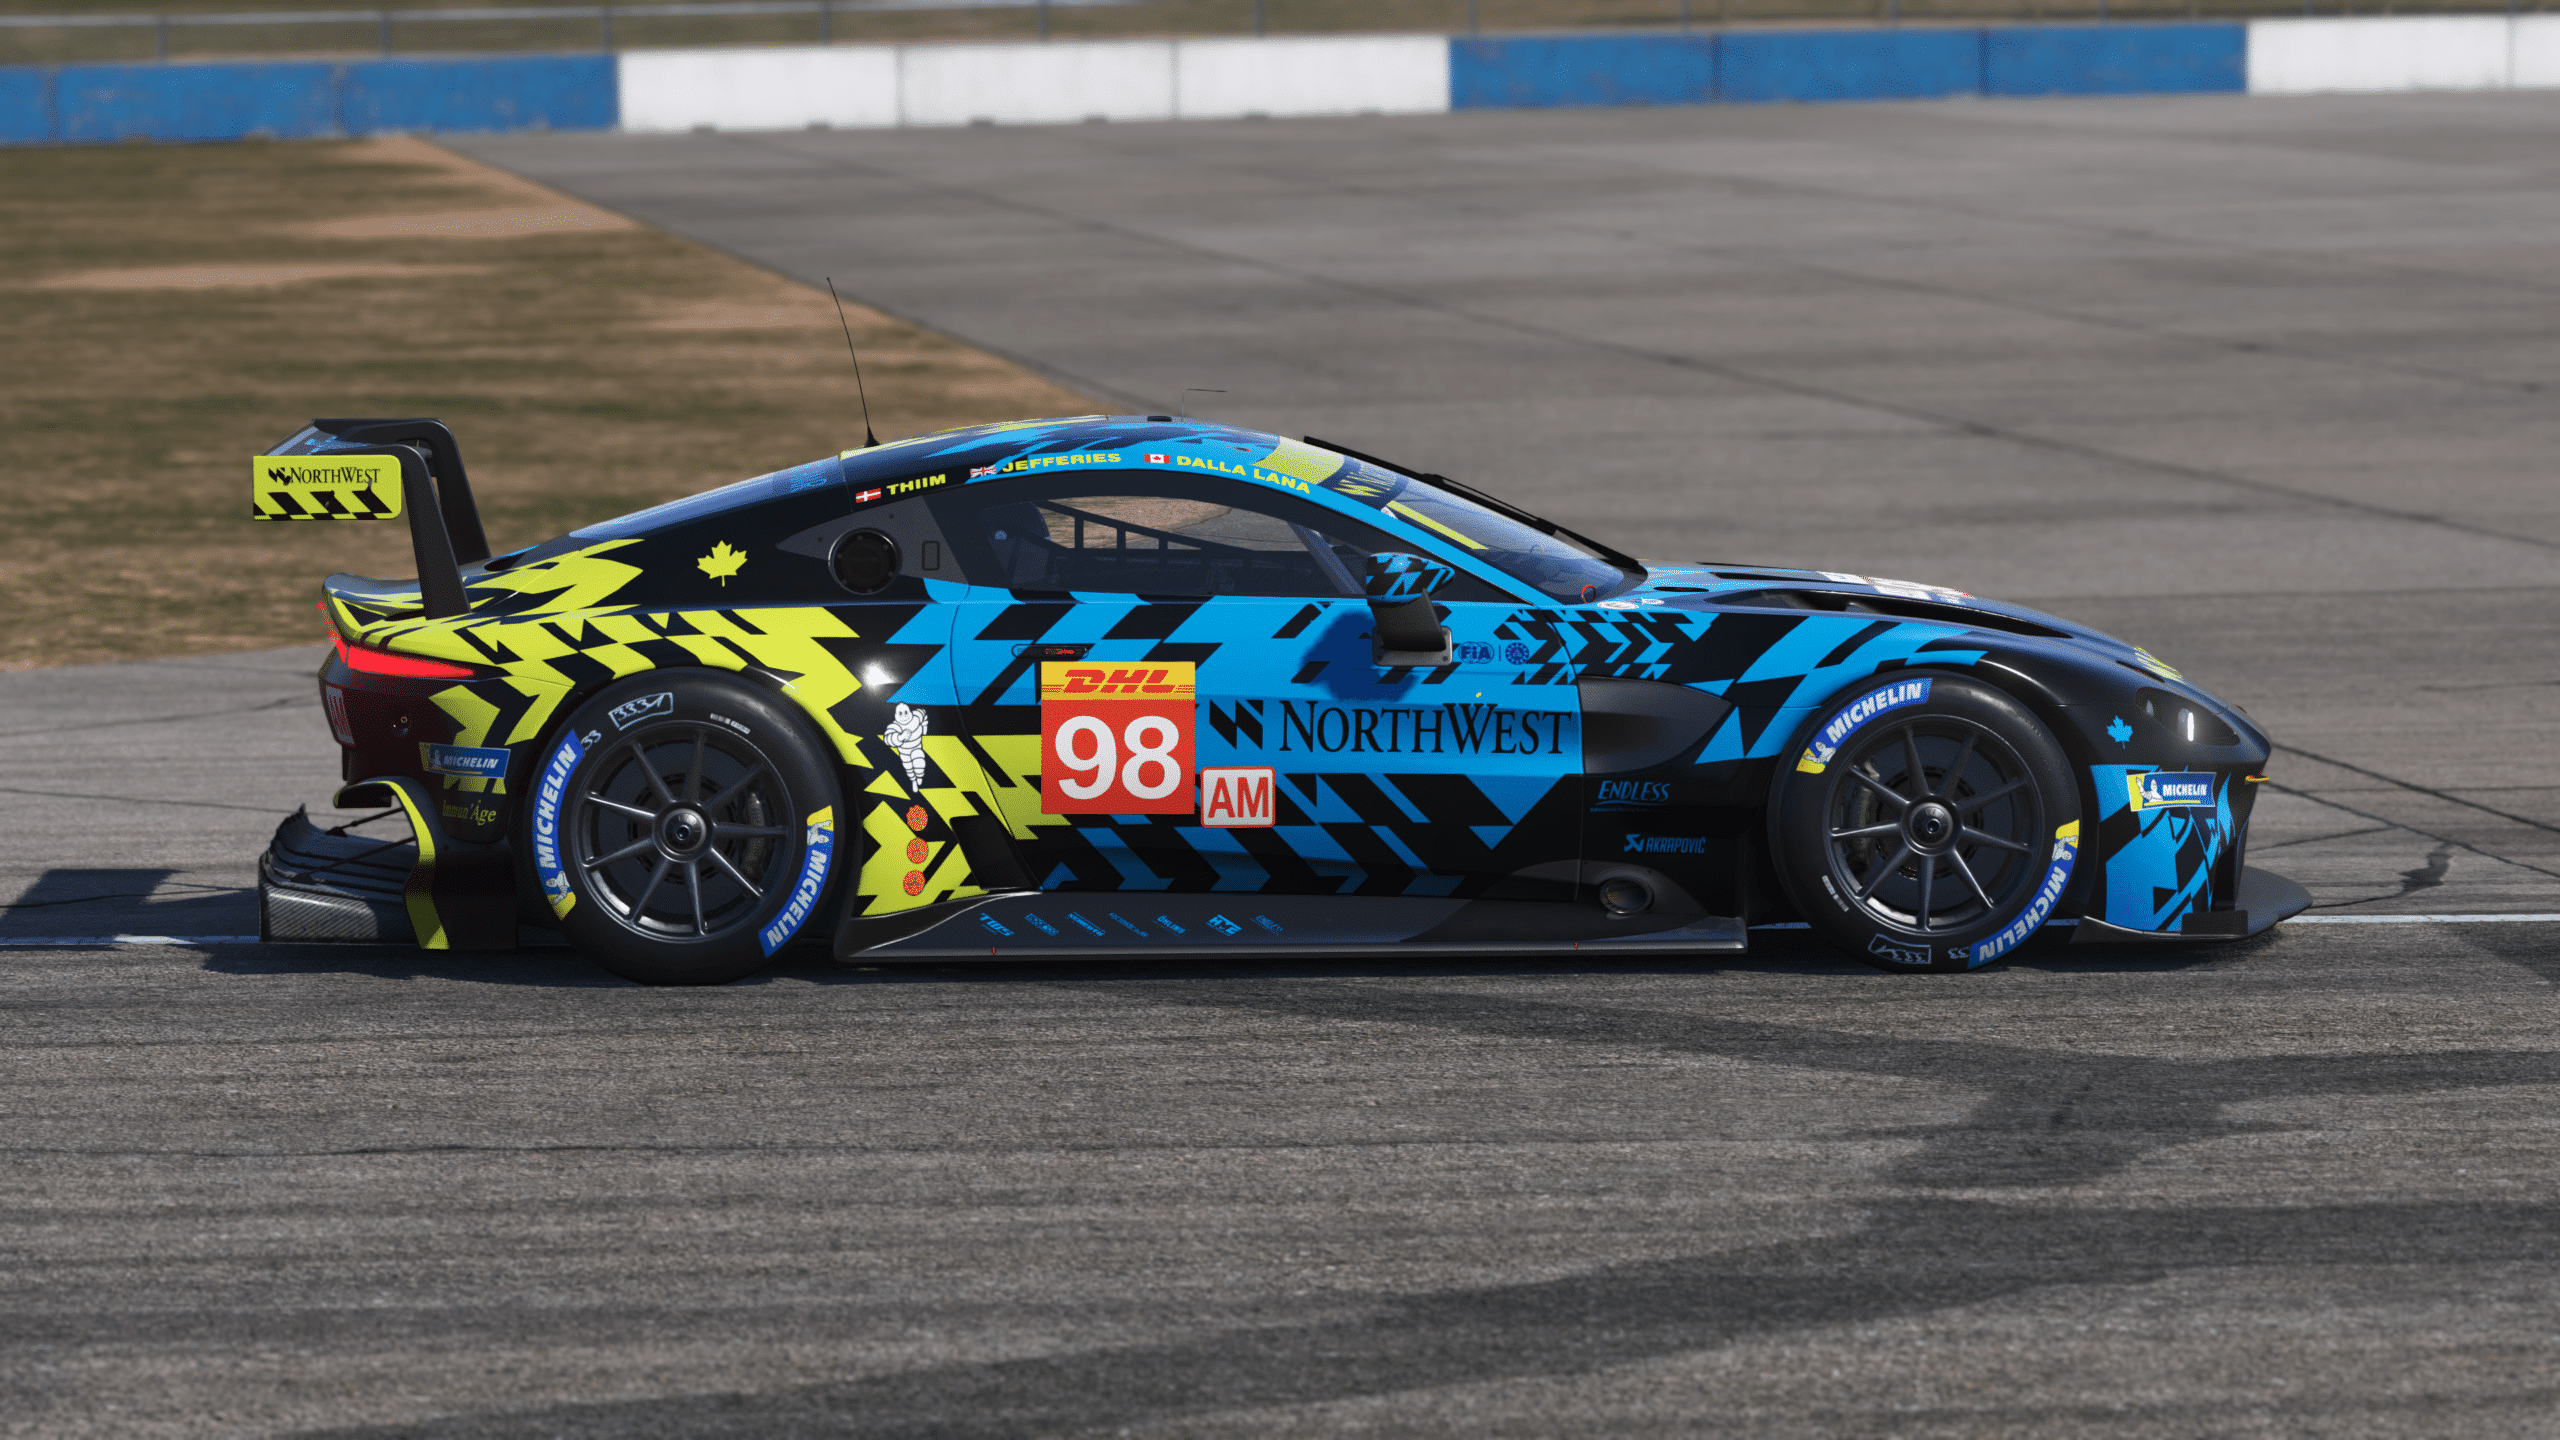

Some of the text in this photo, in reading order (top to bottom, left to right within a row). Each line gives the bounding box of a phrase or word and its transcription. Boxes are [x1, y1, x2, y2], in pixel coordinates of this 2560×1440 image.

[1003, 453, 1121, 473] JEFFERIES
[1177, 455, 1247, 476] DALLA
[1253, 467, 1311, 494] LANA
[886, 473, 947, 496] THIIM
[1063, 669, 1176, 694] DHL
[1825, 682, 1923, 744] MICHELIN
[443, 755, 499, 769] MICHELIN
[1054, 715, 1182, 800] 98
[537, 742, 577, 870] MICHELIN
[1207, 776, 1269, 819] AM
[1598, 780, 1671, 802] ENDLESS
[2162, 783, 2208, 797] MICHELIN
[765, 849, 828, 948] MICHELIN
[1978, 866, 2067, 962] MICHELIN
